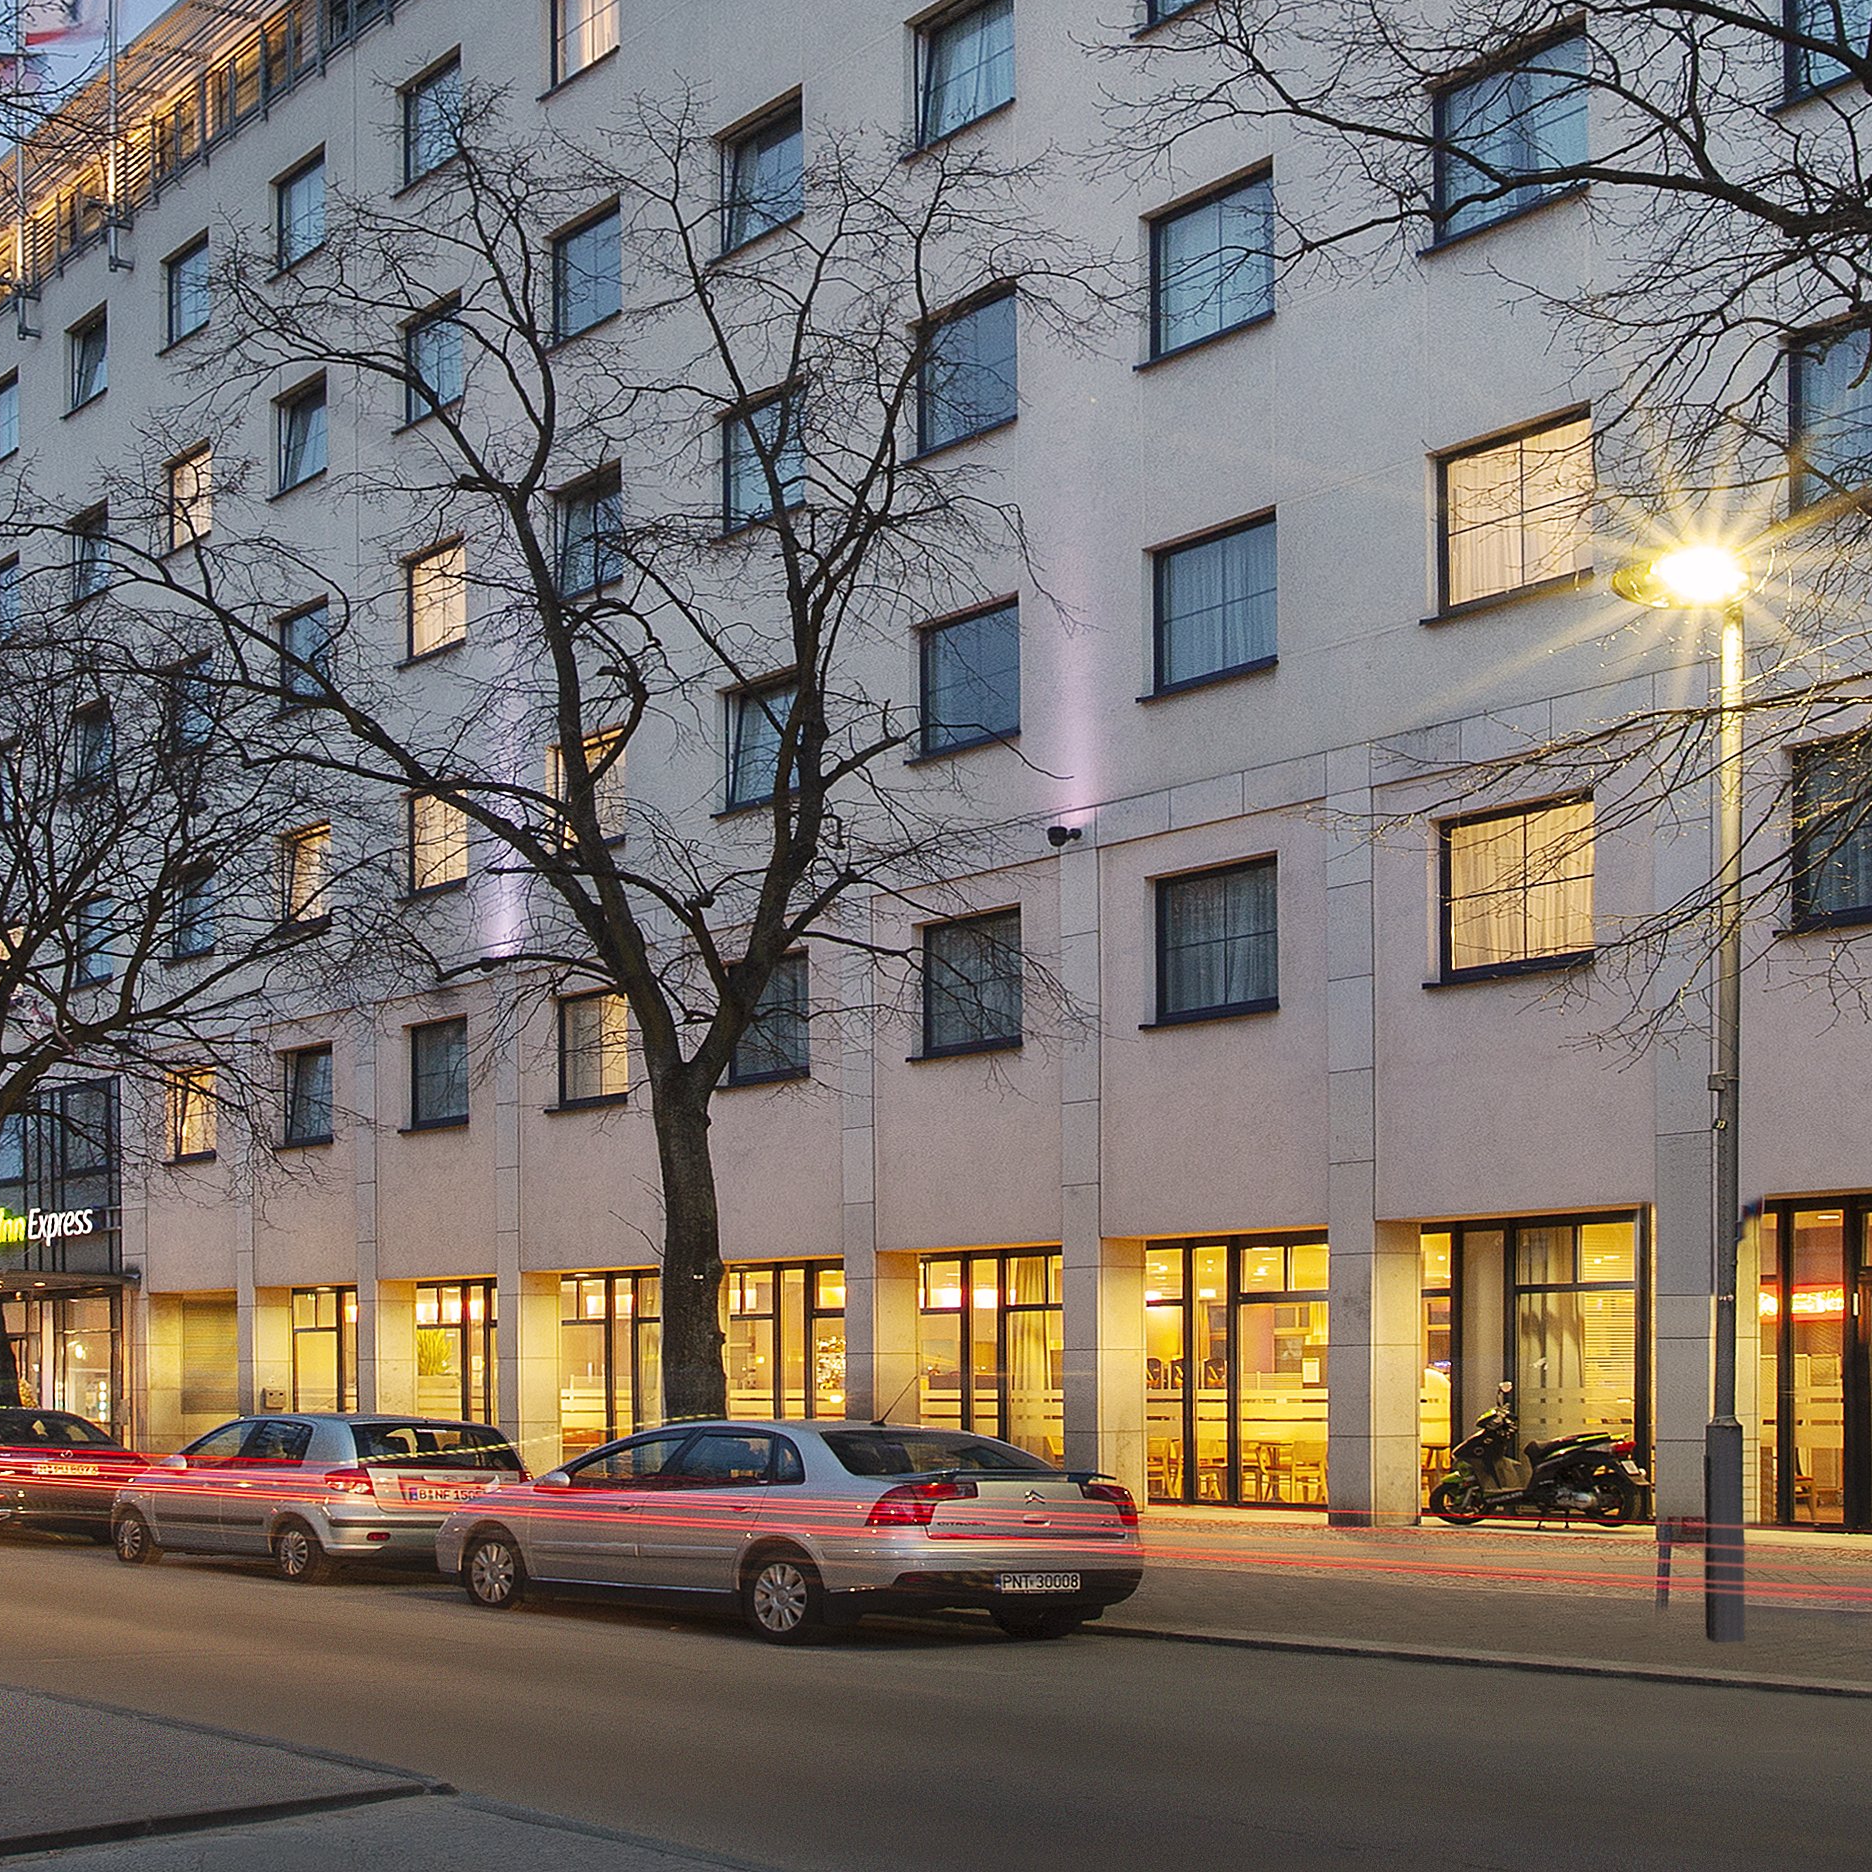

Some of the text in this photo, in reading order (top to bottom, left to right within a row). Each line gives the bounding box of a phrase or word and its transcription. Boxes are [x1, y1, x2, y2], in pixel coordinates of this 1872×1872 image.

[27, 1207, 93, 1248] Express
[435, 1489, 451, 1501] NF
[1002, 1573, 1079, 1589] PNT 30008
